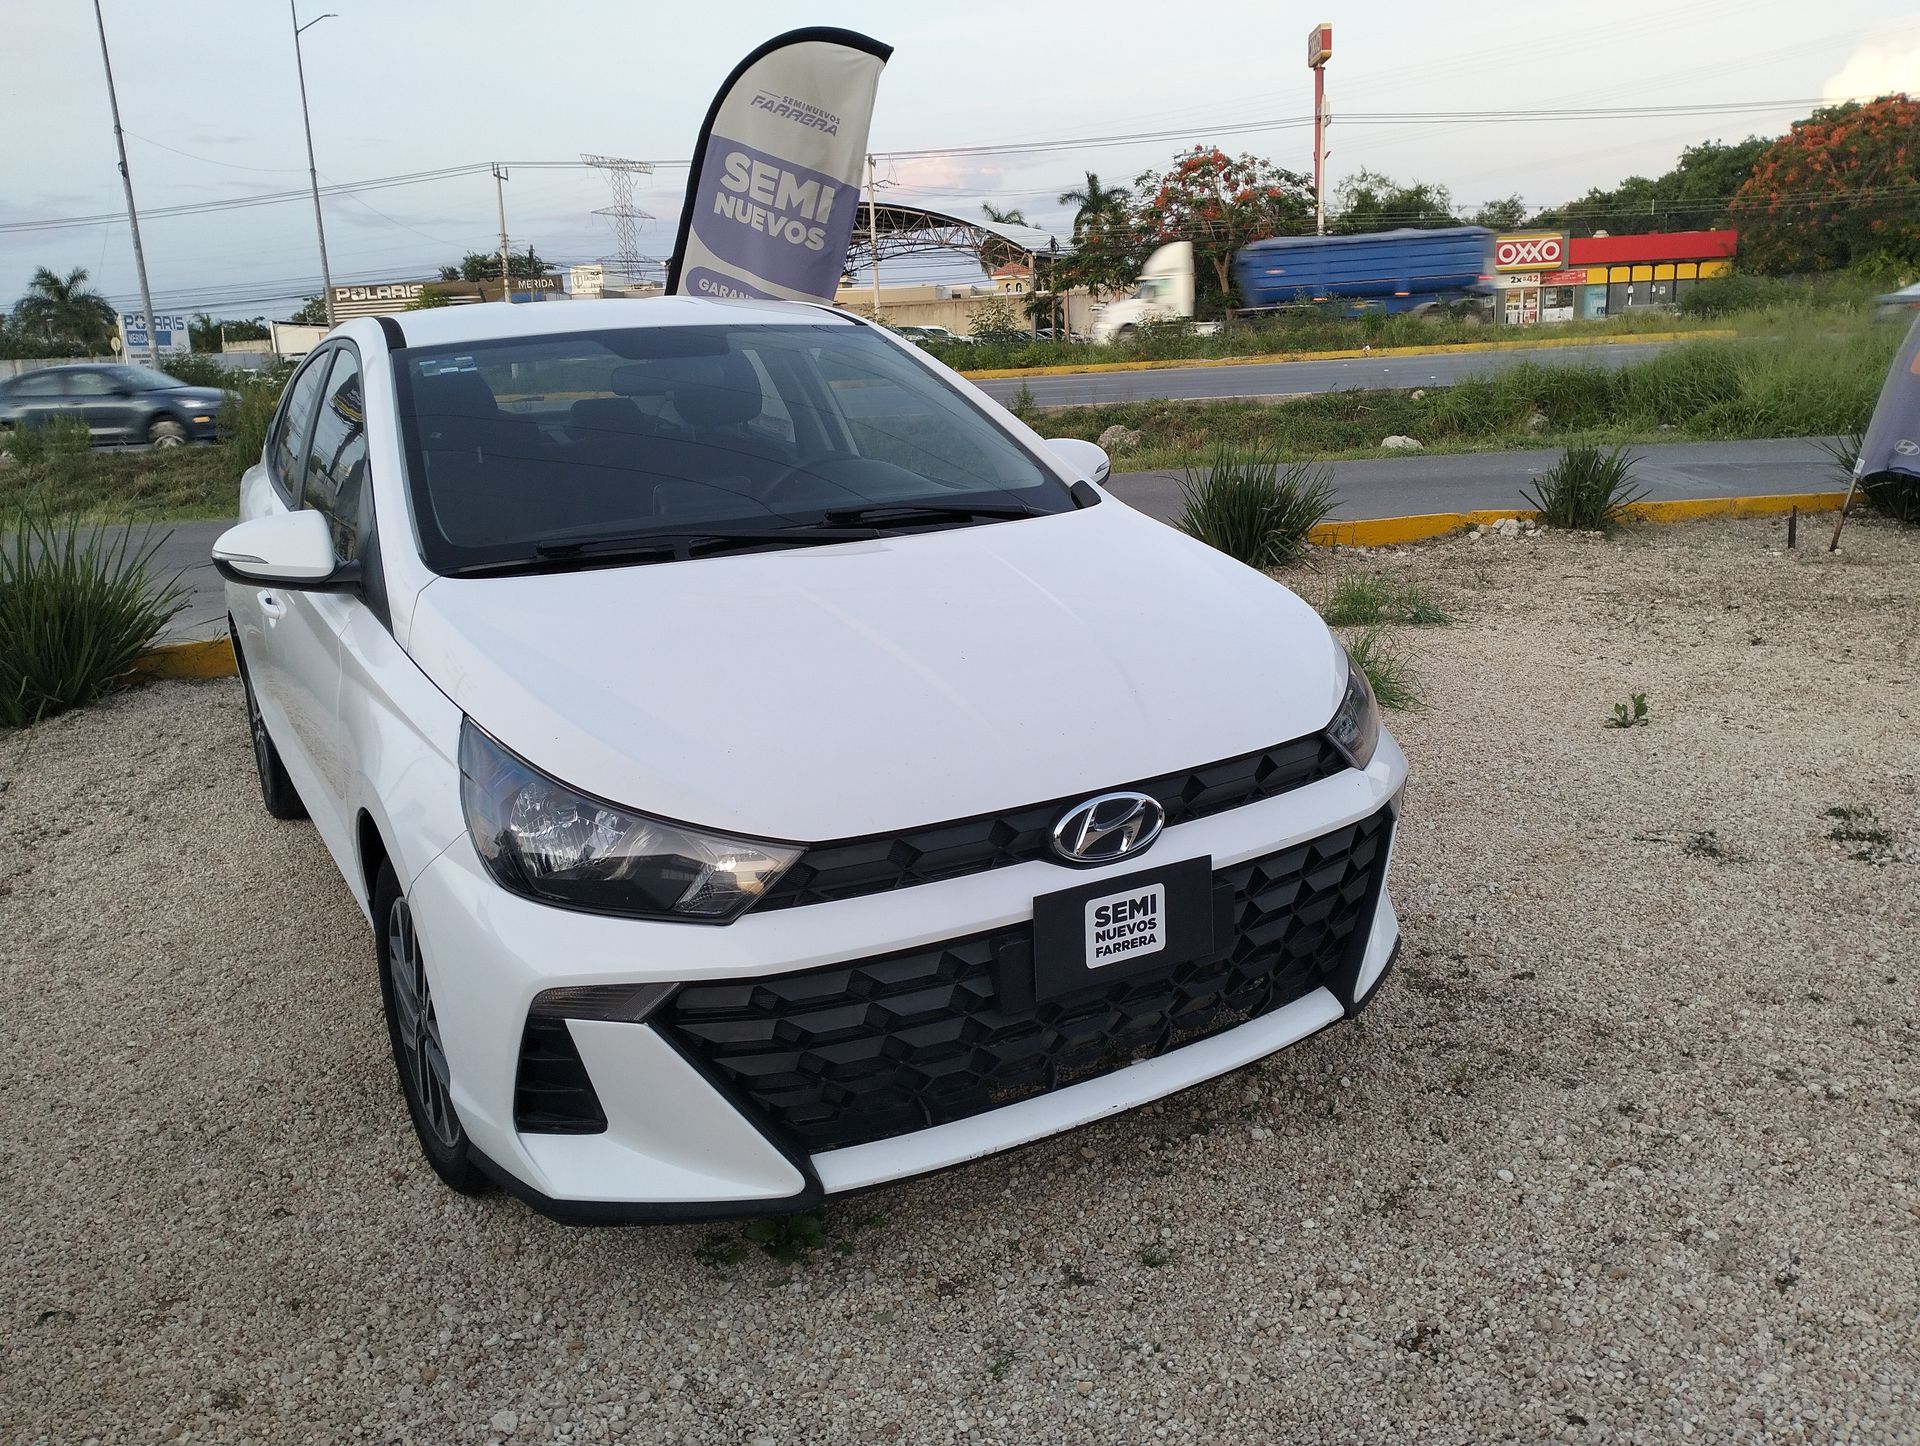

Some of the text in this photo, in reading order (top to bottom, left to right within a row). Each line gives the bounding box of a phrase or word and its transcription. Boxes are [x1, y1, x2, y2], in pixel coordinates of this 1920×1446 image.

[750, 95, 838, 137] FARRERA
[782, 95, 841, 125] SEMINUEVOS
[720, 151, 836, 225] SEMI
[713, 191, 827, 251] NUEVOS
[1498, 239, 1561, 265] OXXO
[335, 284, 424, 301] POLARIS
[698, 278, 755, 300] GARAN
[123, 314, 185, 331] POARIS
[1094, 893, 1157, 928] SEMI
[1095, 917, 1157, 943] NUEVOS
[1095, 933, 1157, 958] FARRERA
